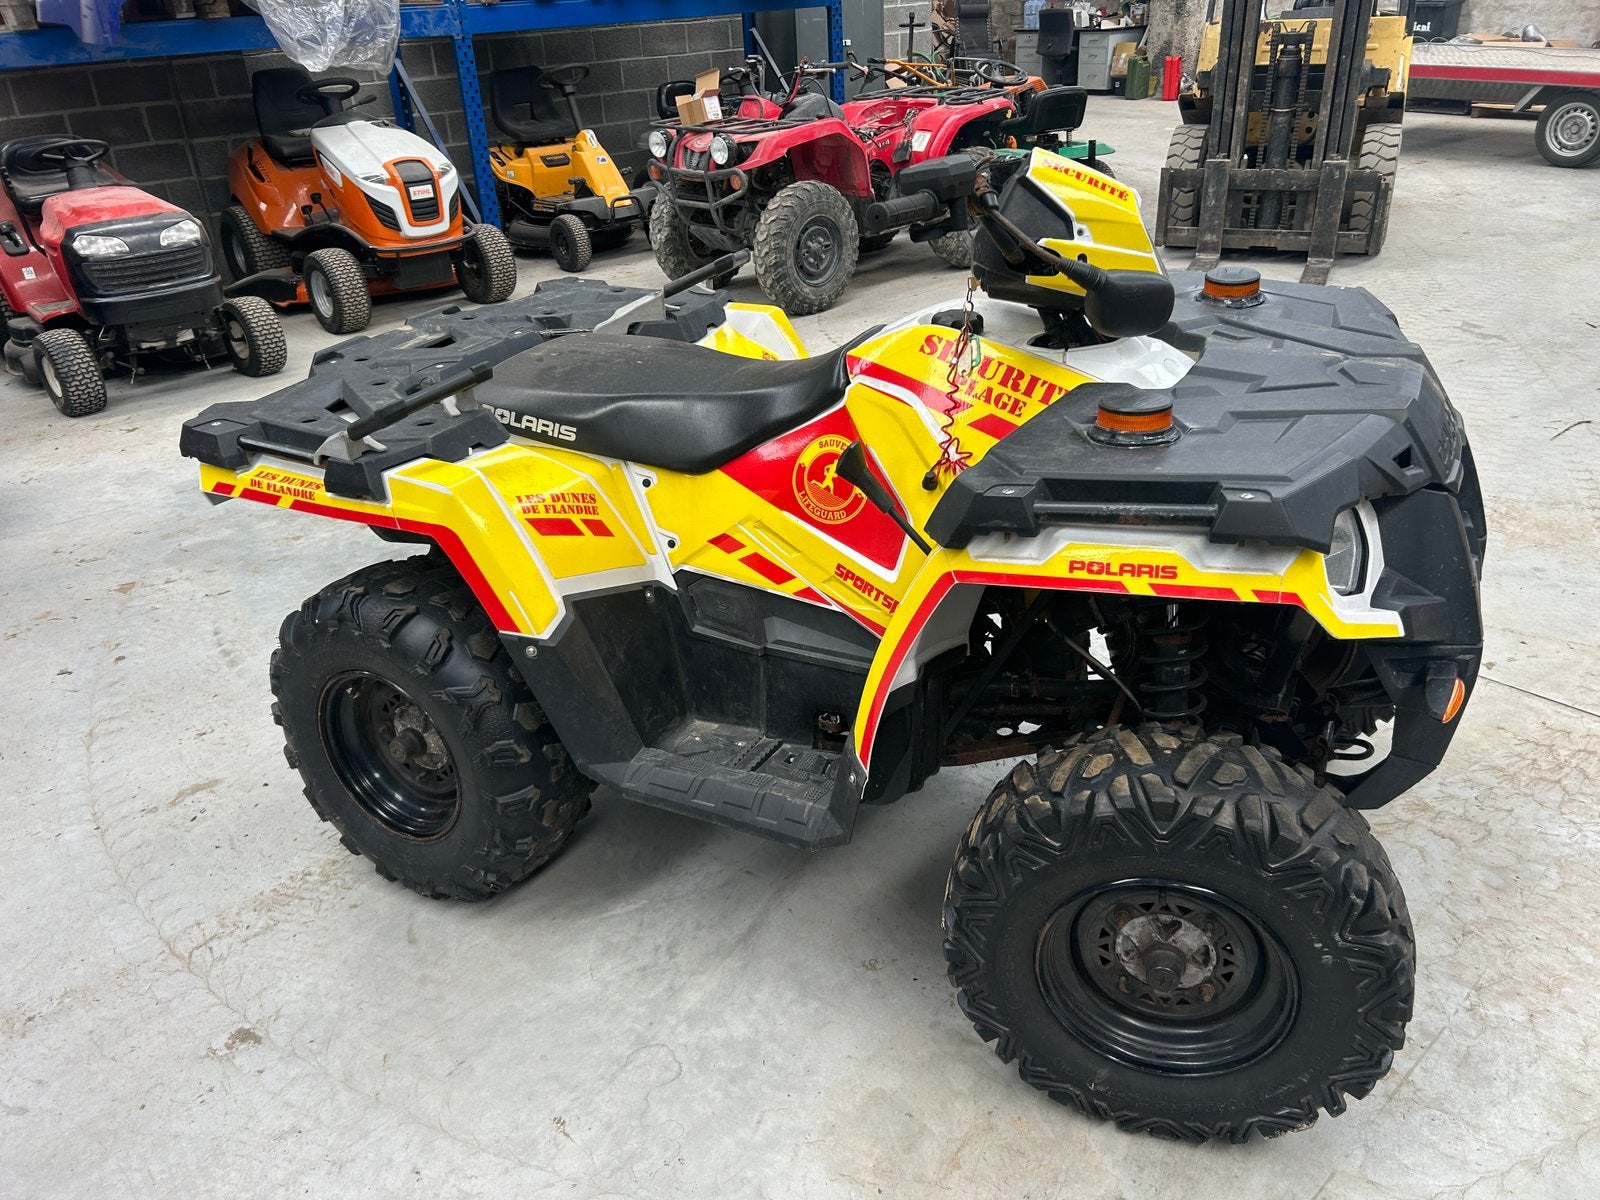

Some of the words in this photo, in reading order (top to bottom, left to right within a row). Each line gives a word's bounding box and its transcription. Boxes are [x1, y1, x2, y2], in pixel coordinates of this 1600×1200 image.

[412, 188, 432, 196] STIHL
[818, 439, 847, 450] SAUVE
[255, 471, 280, 480] LES
[279, 475, 323, 490] DUNES
[250, 478, 263, 489] DE
[267, 482, 315, 500] FLANDRE
[515, 493, 546, 504] LES
[549, 492, 597, 504] DUNES
[799, 490, 847, 520] LIFEGUARD
[520, 504, 540, 514] DE
[543, 504, 599, 516] FLANDRE
[1069, 560, 1178, 580] POLARIS
